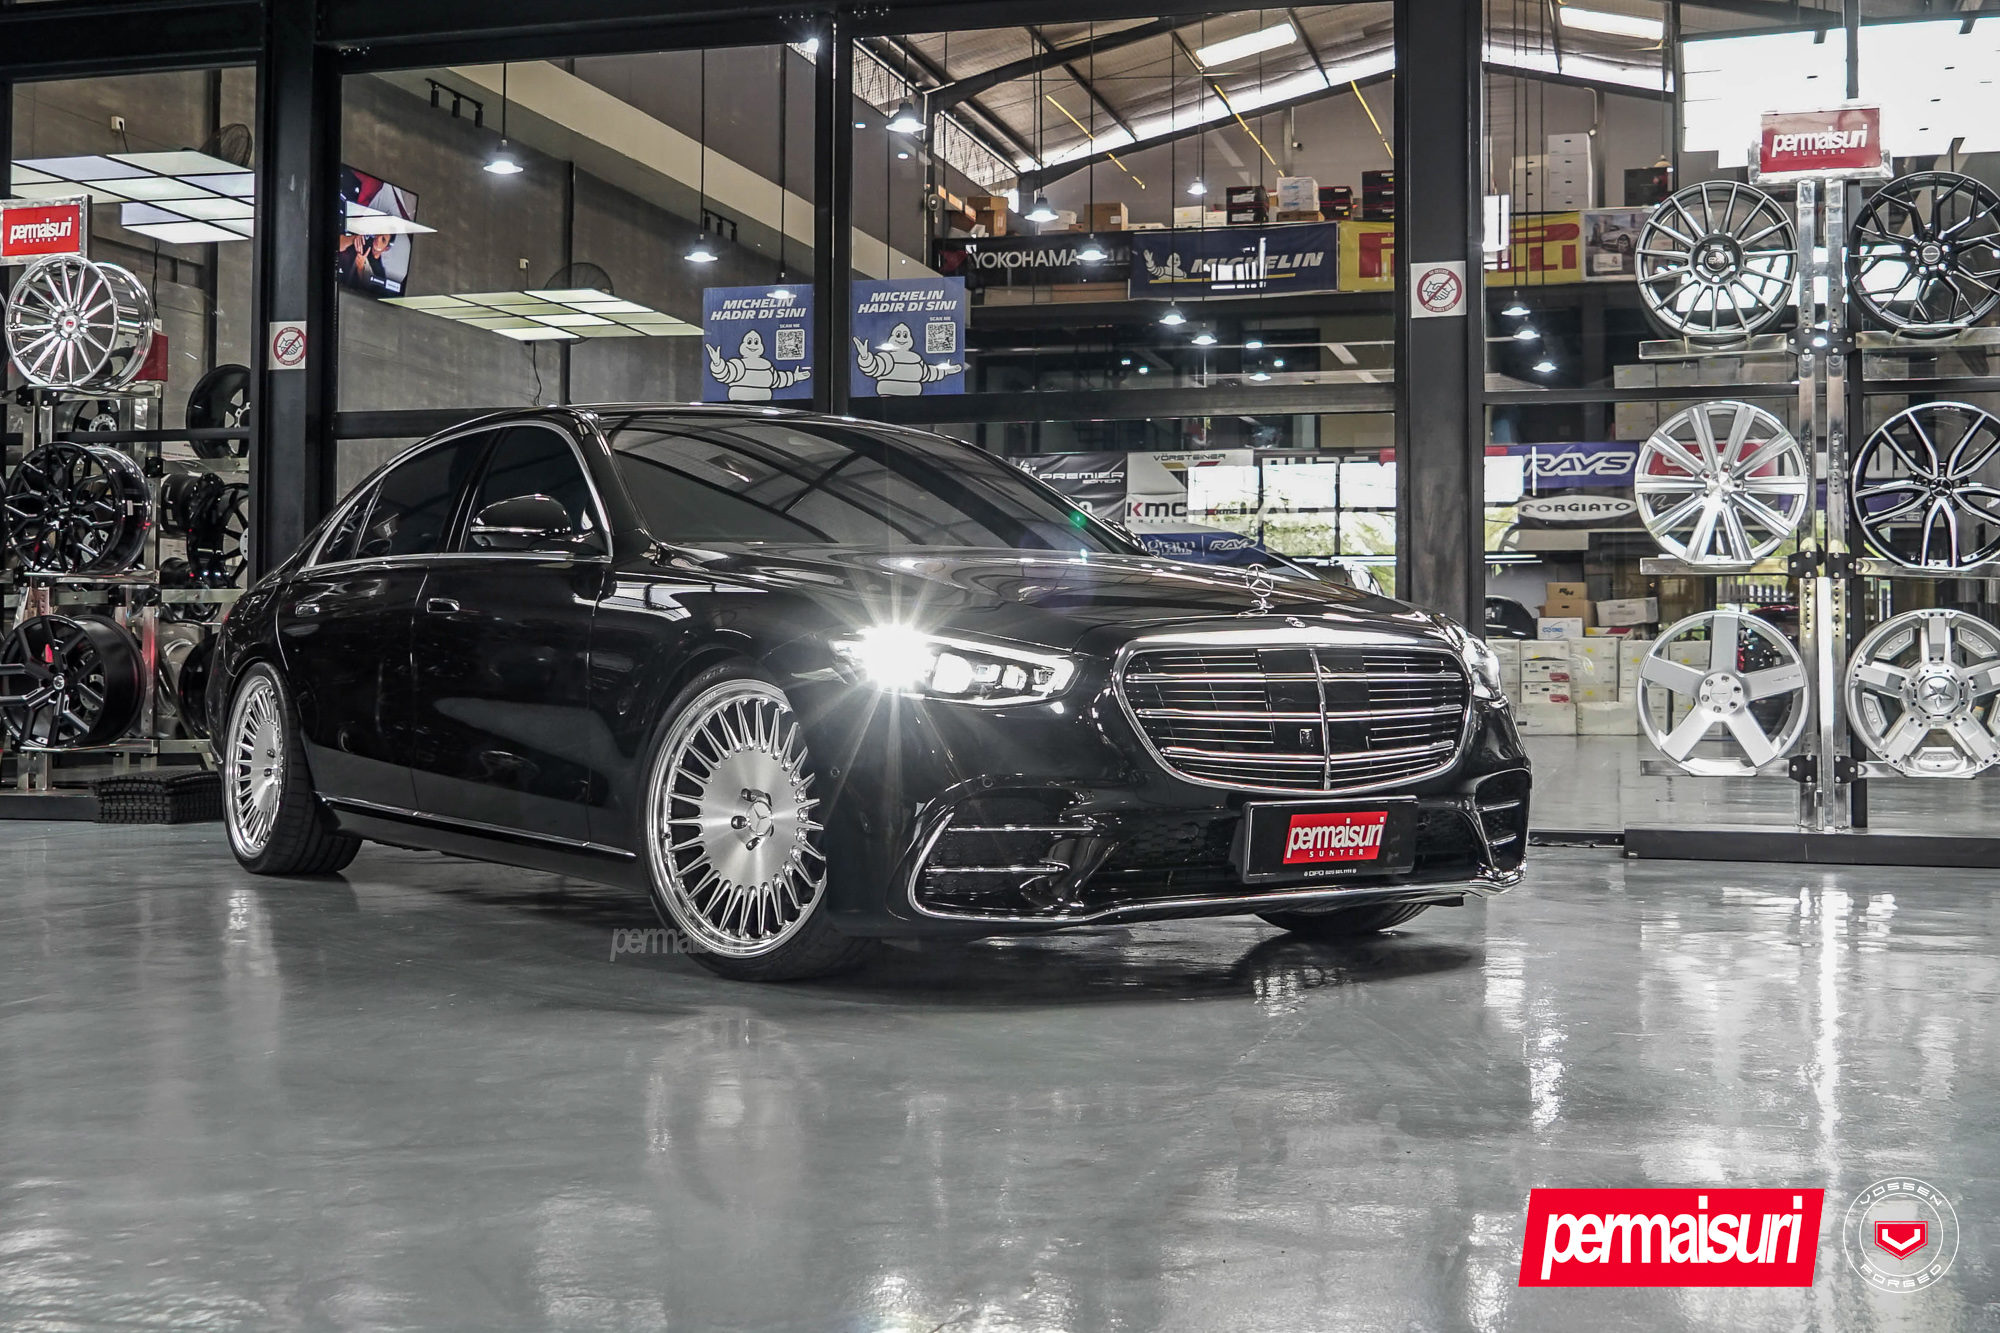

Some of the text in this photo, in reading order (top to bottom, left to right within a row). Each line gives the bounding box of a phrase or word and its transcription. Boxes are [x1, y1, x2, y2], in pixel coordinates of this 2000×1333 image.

[1771, 124, 1868, 157] permaisuri
[9, 216, 72, 244] permaisuri
[973, 249, 1081, 269] YOKOHAMA
[870, 290, 944, 303] MICHELIN
[722, 298, 794, 310] MICHELIN
[857, 300, 957, 314] HADIR DI SINI
[710, 308, 806, 321] HADIR DI SINI
[1522, 451, 1636, 476] RAYS
[1039, 471, 1125, 480] PREMIER
[1521, 502, 1631, 513] FORGIATO
[1286, 816, 1385, 859] permaisuri
[1309, 848, 1364, 858] SUNTER
